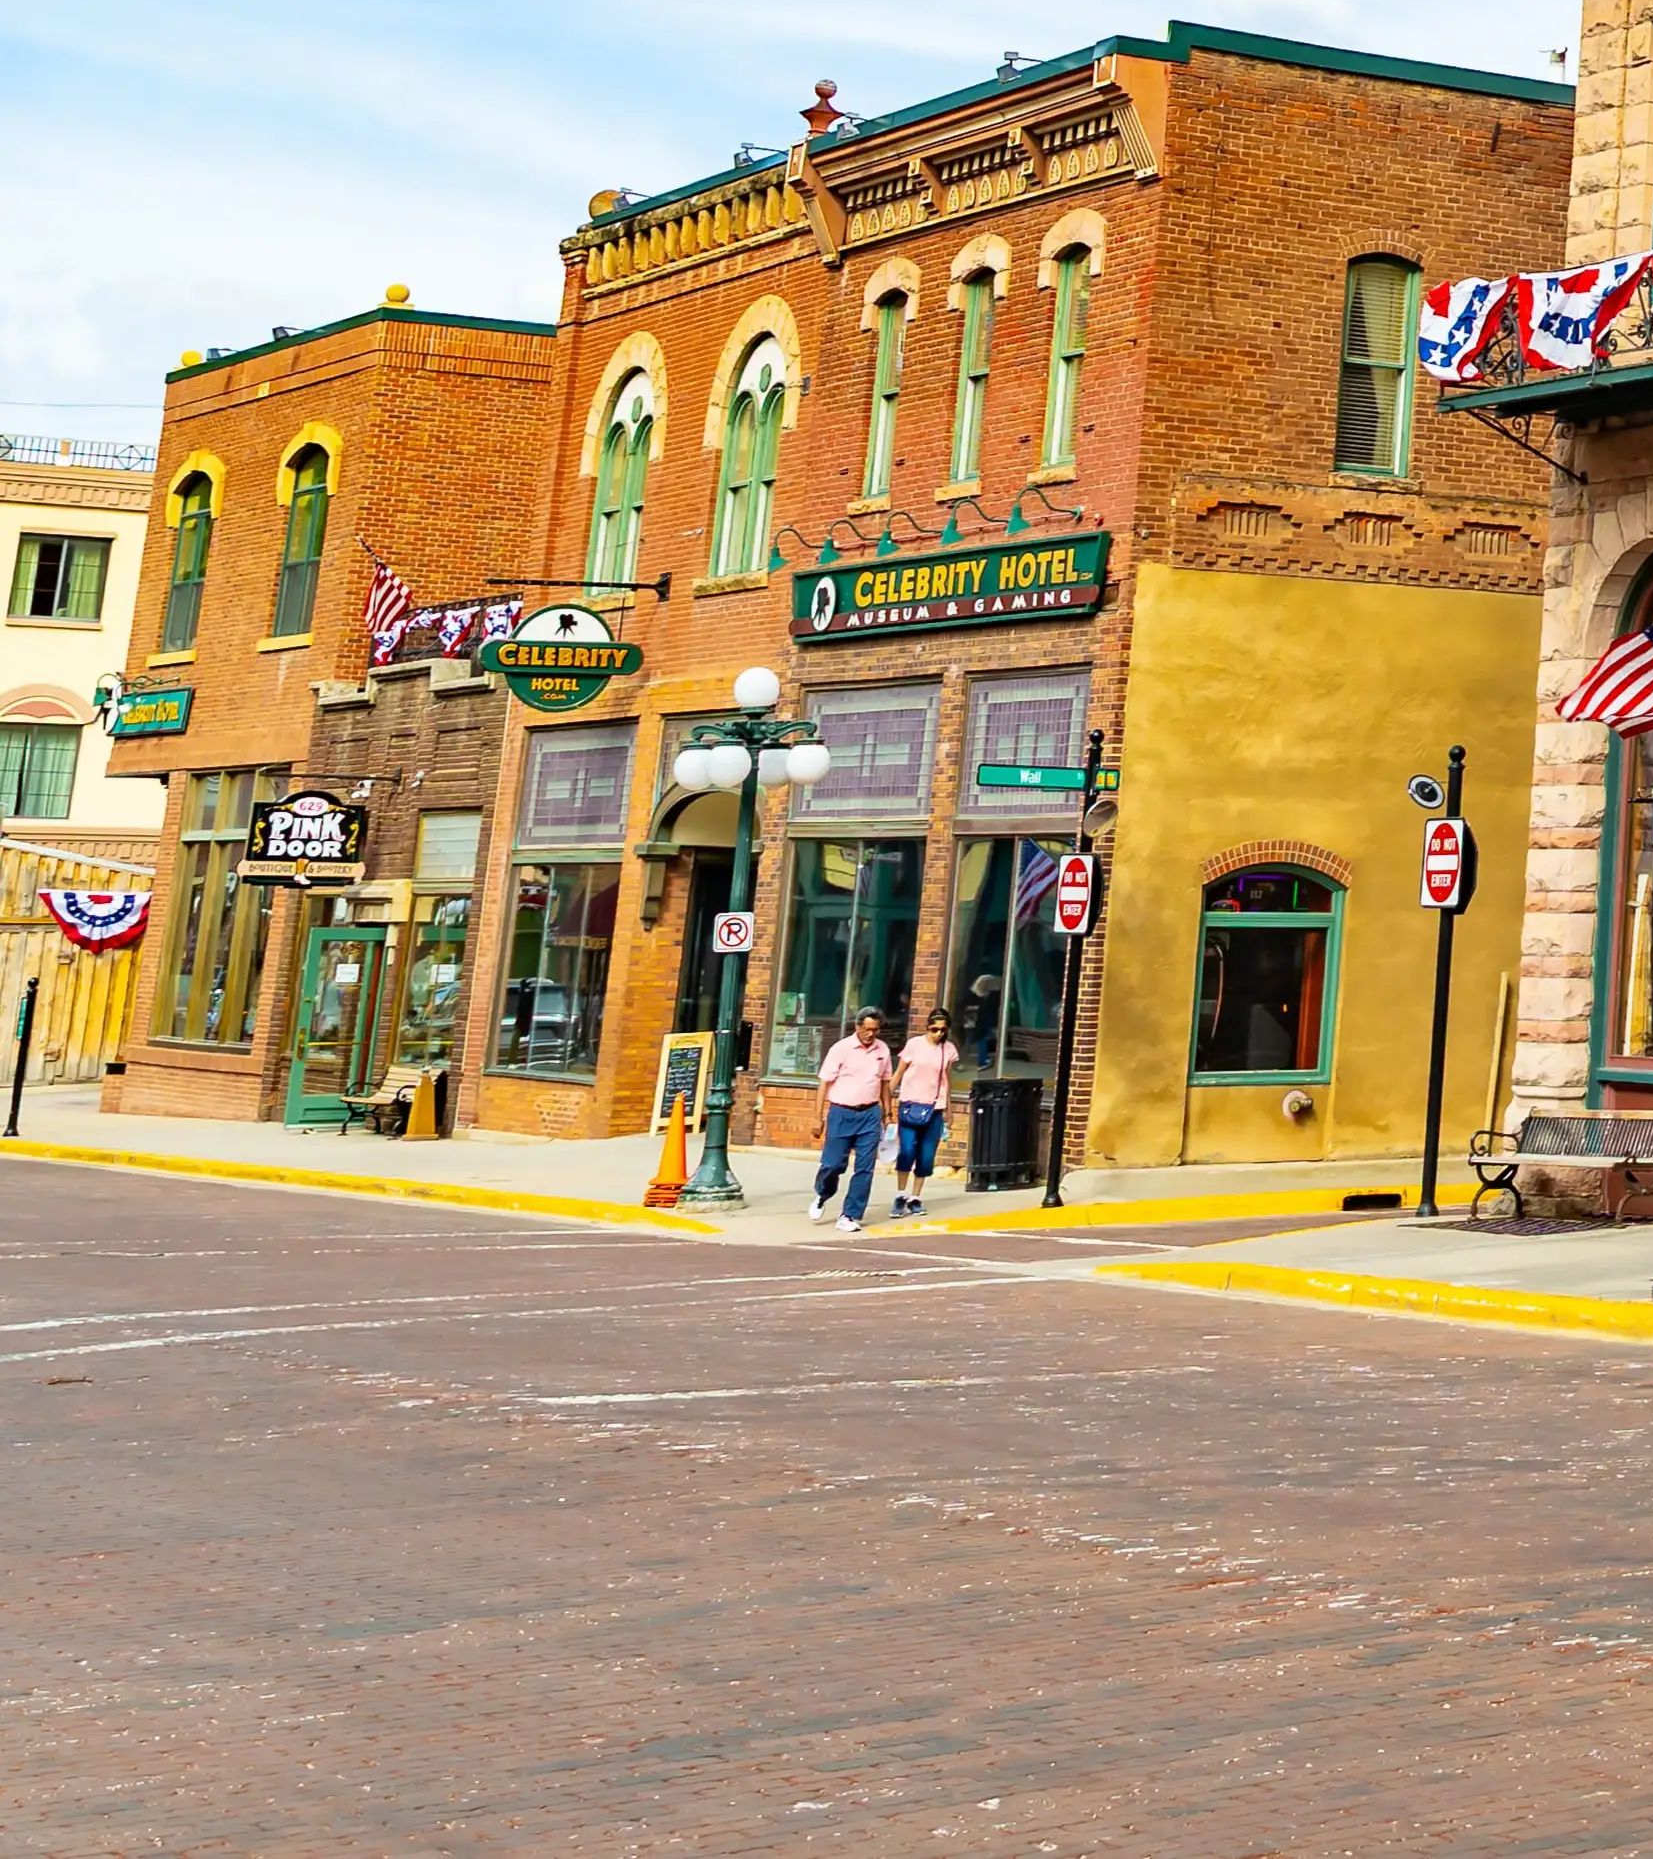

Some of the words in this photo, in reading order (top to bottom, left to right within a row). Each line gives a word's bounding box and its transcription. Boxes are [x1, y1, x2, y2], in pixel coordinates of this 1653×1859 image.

[855, 558, 988, 608] CELEBRITY
[999, 548, 1078, 590] HOTEL
[846, 605, 929, 627] MUSEUM
[946, 602, 958, 616] &
[973, 589, 1072, 614] GAMING
[498, 643, 629, 669] CELEBRITY
[531, 678, 580, 691] HOTEL
[1019, 769, 1042, 784] Wall
[299, 802, 323, 812] 629
[268, 811, 346, 841] PINK
[266, 839, 342, 857] DOOR
[1431, 838, 1441, 851] DO
[1443, 838, 1456, 851] NOT
[1064, 872, 1072, 883] DO
[1075, 872, 1086, 883] NOT
